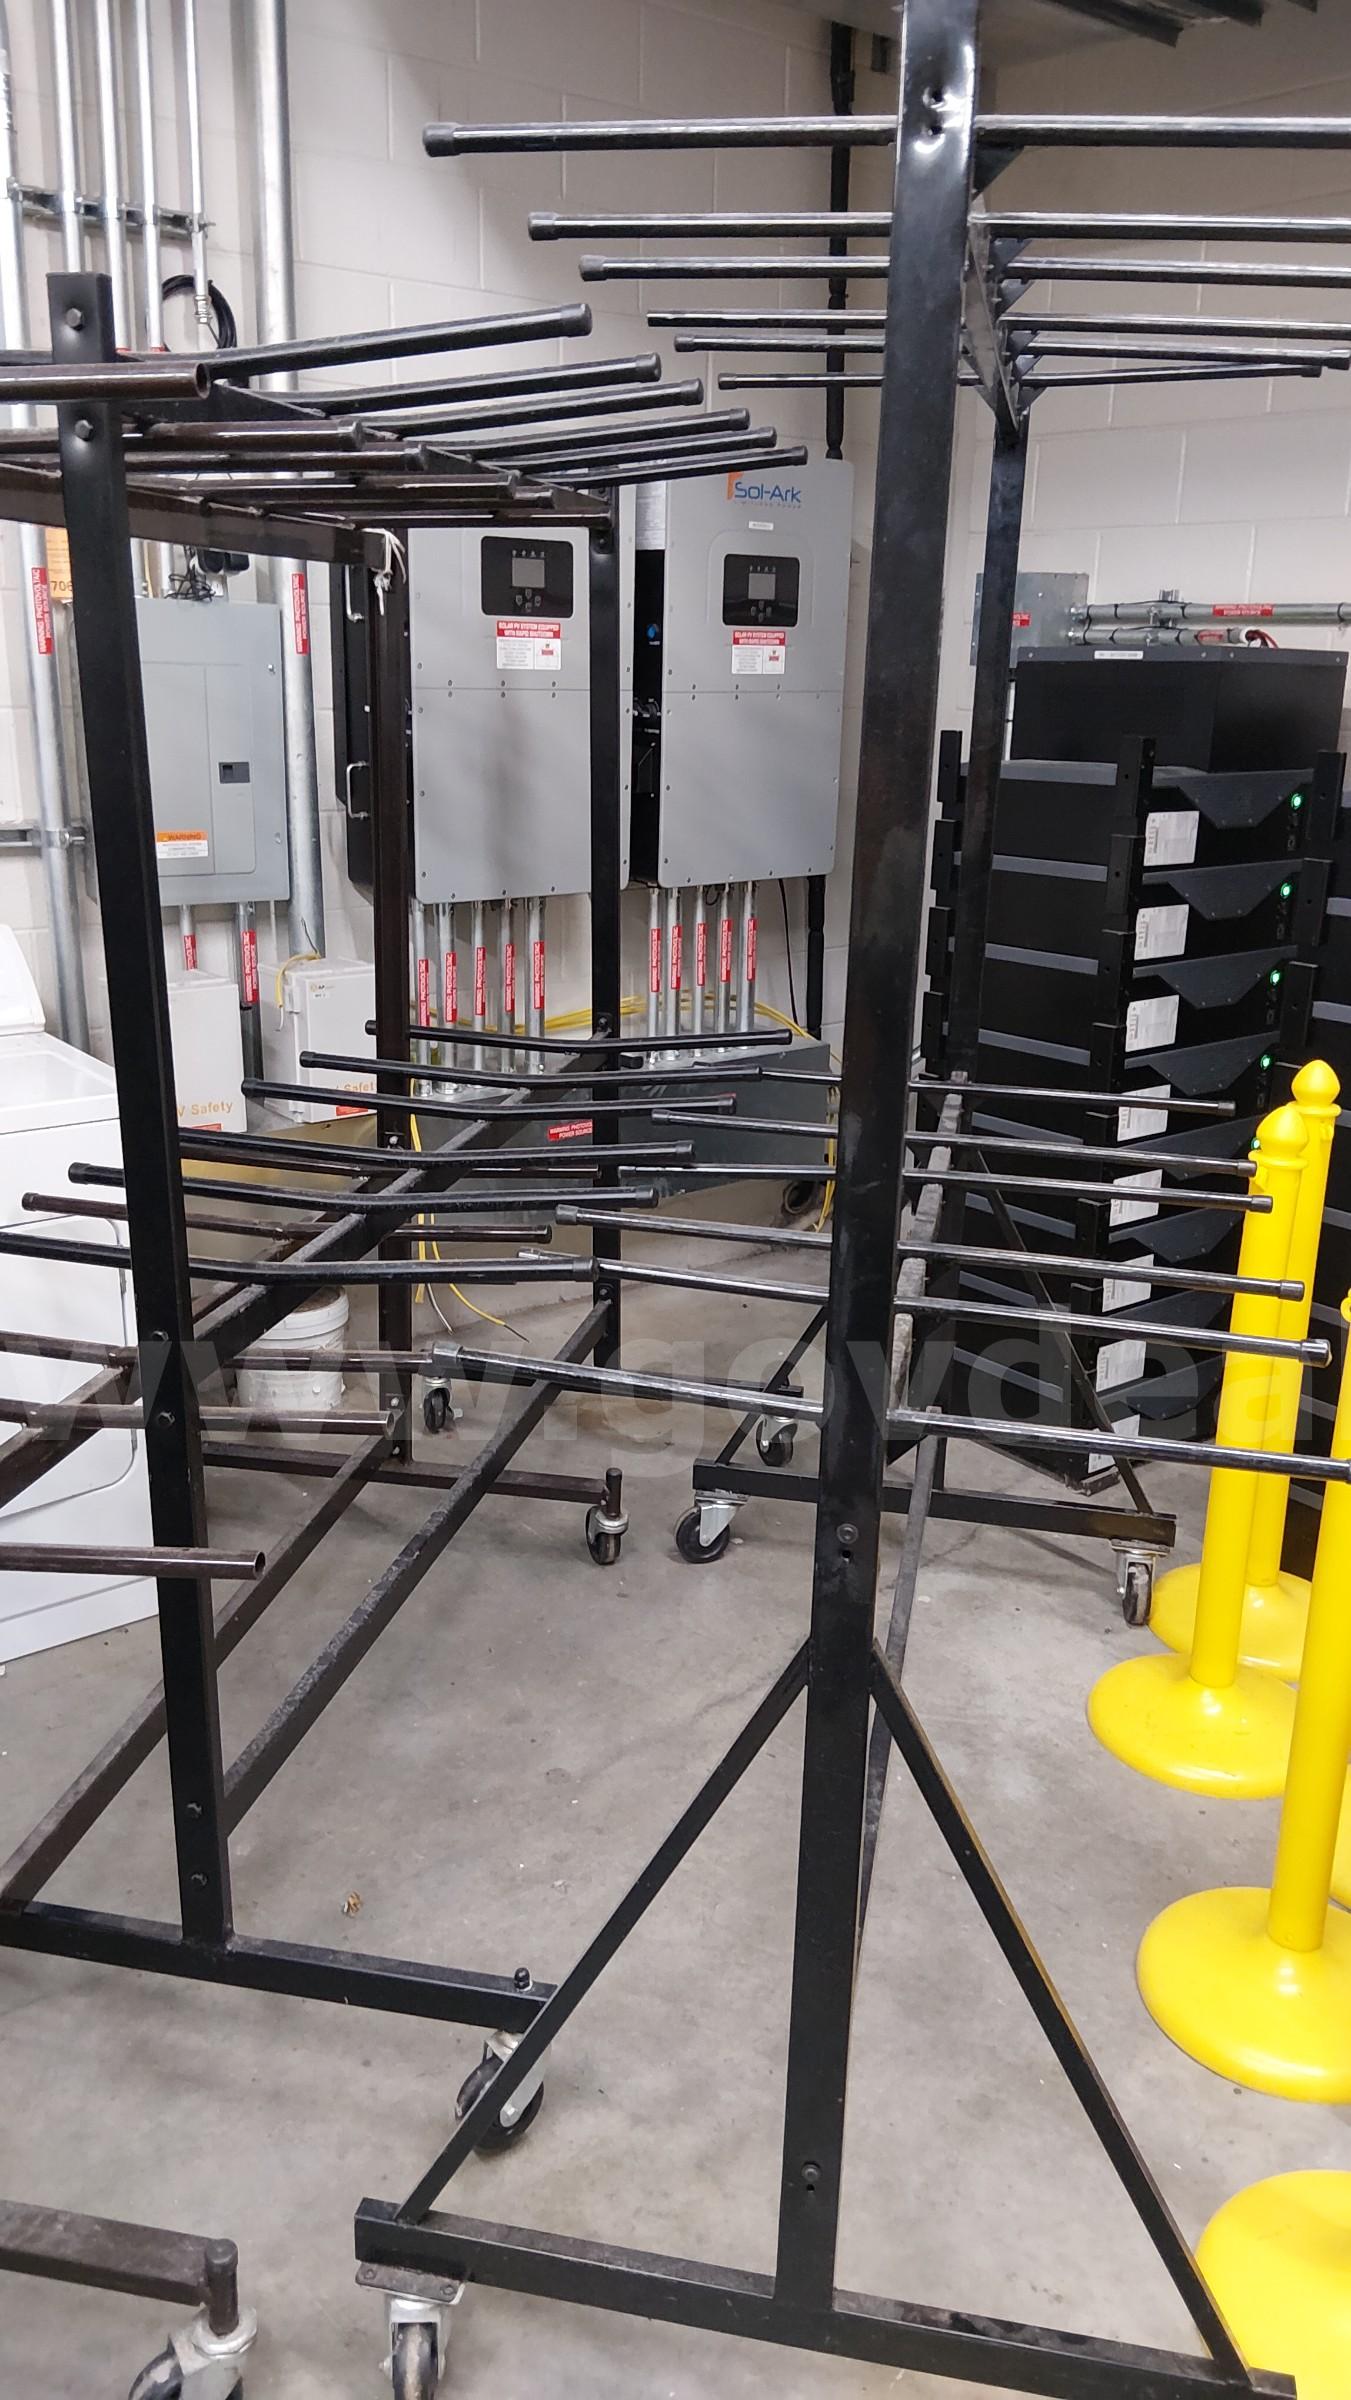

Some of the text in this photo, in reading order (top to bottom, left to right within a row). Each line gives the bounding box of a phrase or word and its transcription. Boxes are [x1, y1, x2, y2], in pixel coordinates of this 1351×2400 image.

[735, 482, 801, 503] Sol-Ark
[32, 568, 44, 619] PHOTOVOLTAIC
[192, 1101, 233, 1116] Safety
